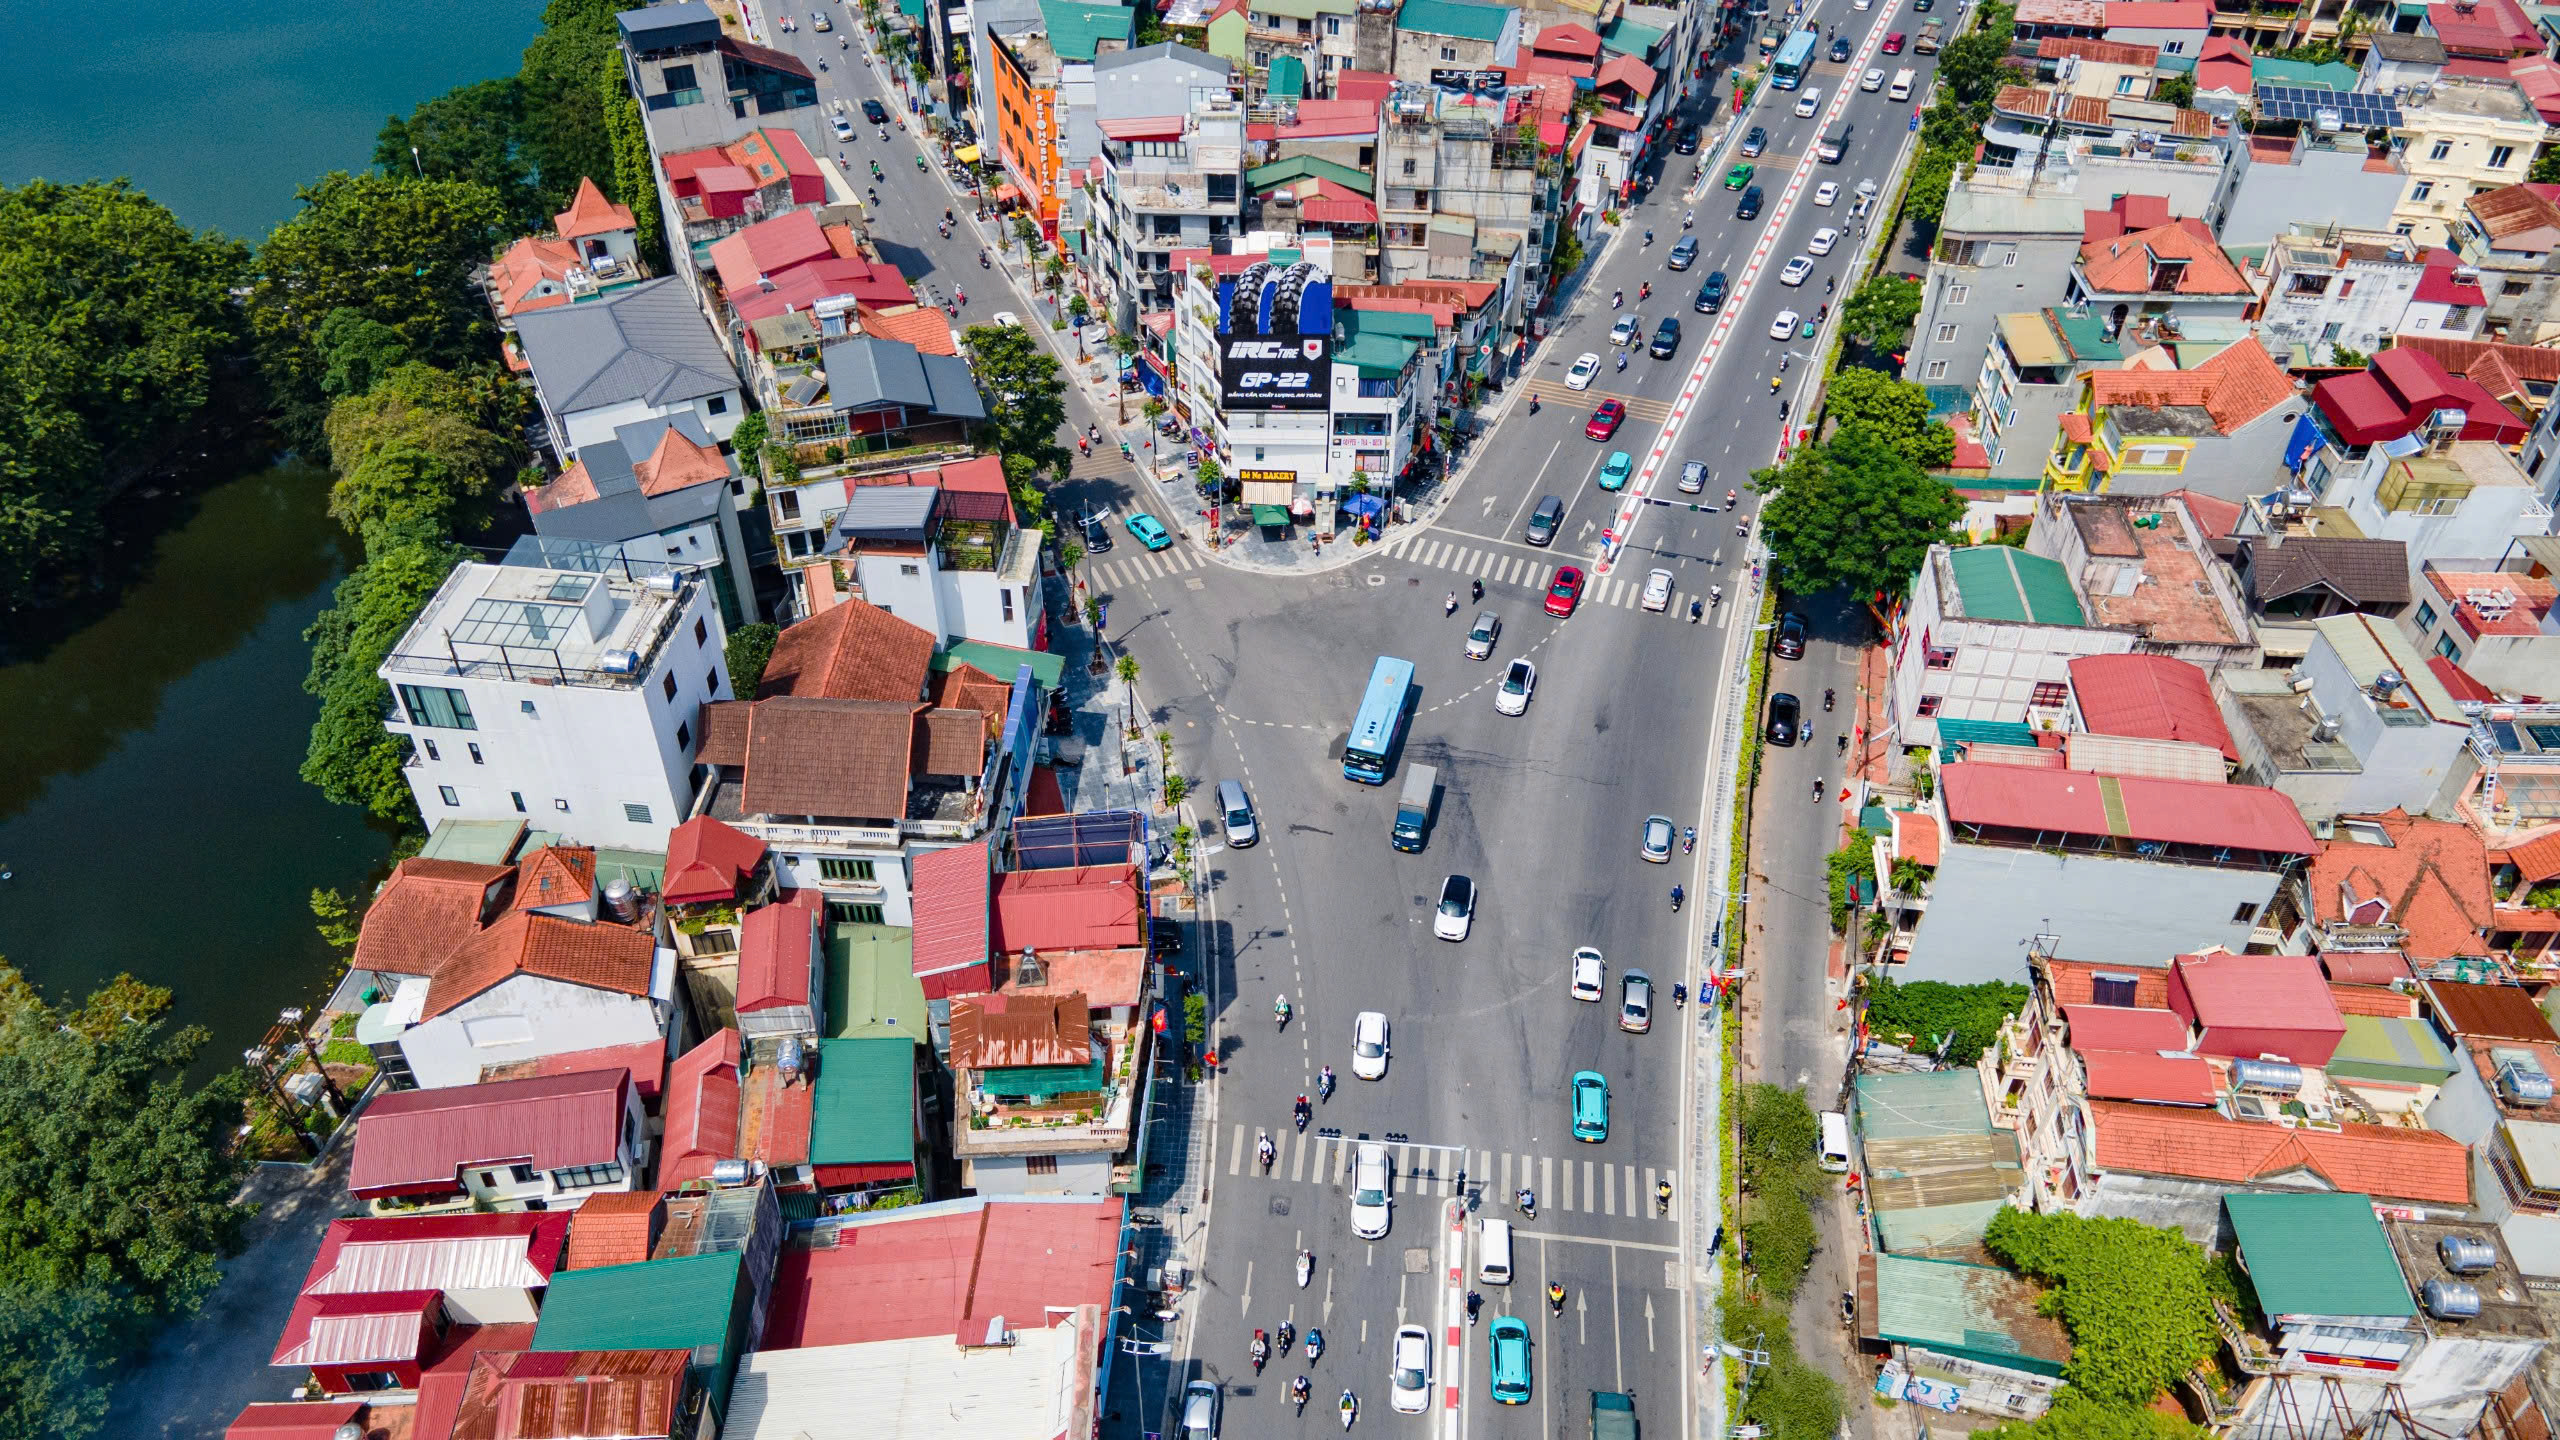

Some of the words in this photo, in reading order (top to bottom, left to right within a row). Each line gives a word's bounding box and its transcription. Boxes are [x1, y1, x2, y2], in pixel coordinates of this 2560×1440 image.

[1035, 95, 1044, 119] PET
[1038, 132, 1050, 194] HOSPITAL
[1277, 348, 1299, 359] TIRE
[1240, 372, 1311, 388] GP-22
[1263, 471, 1296, 481] BAKERY
